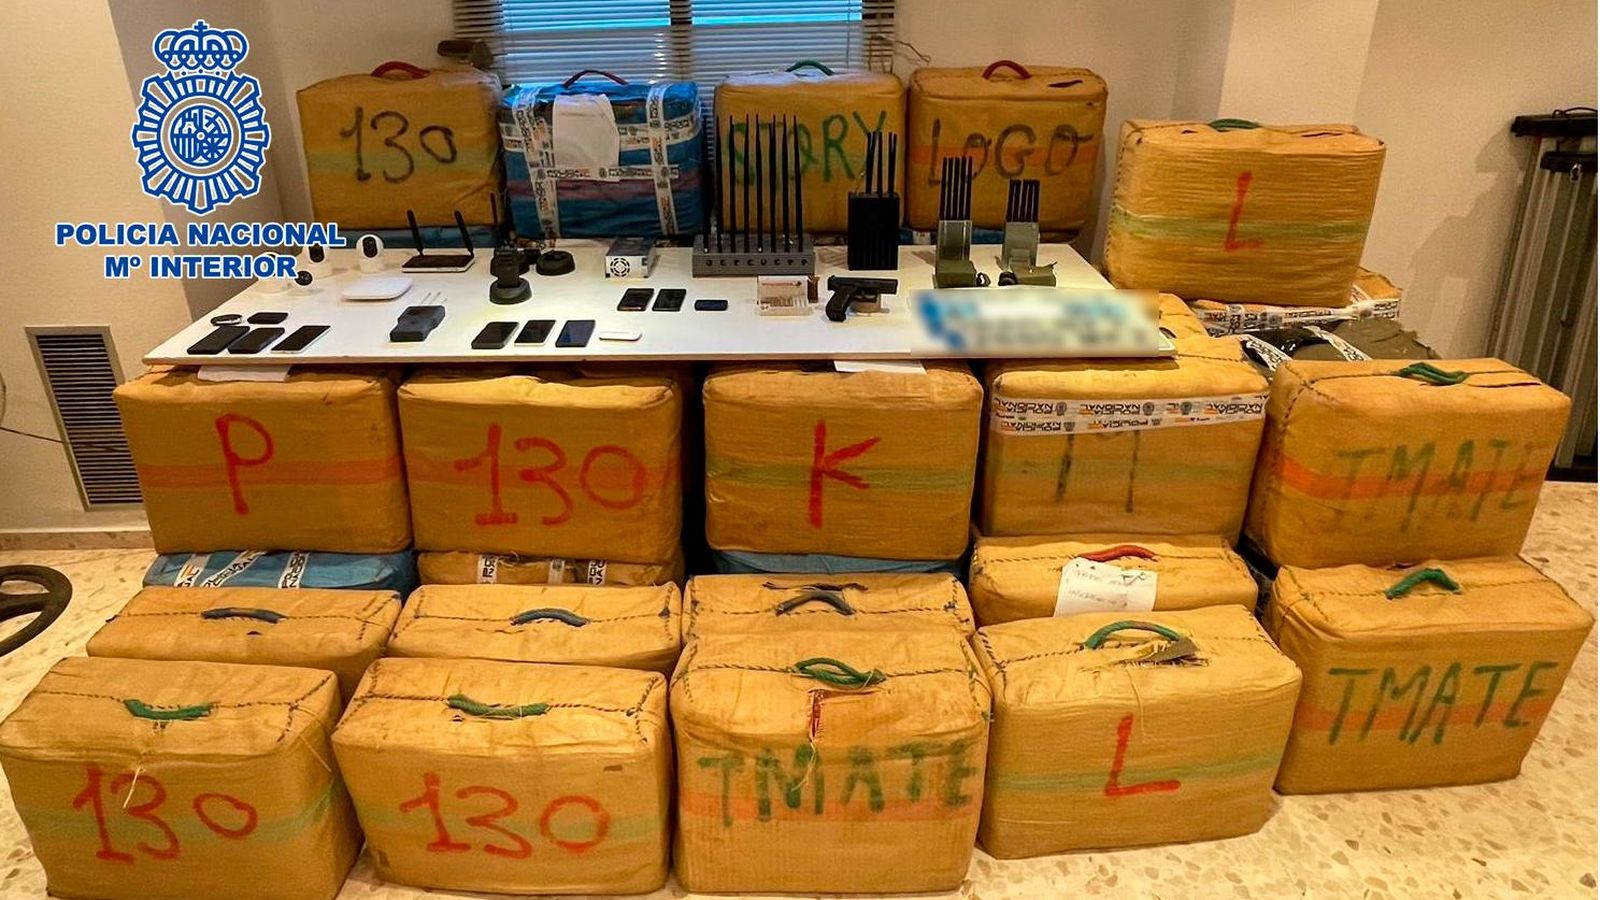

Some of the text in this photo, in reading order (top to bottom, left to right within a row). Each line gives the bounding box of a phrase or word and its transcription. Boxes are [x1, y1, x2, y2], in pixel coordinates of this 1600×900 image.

[339, 106, 457, 183] 130
[928, 118, 1094, 187] LOGO
[1225, 171, 1263, 252] L
[216, 413, 274, 515] P
[455, 424, 646, 525] 130
[809, 421, 881, 528] K
[1327, 662, 1559, 745] TMATE
[697, 741, 978, 827] TMATE
[1105, 713, 1182, 797] L
[74, 764, 258, 862] 130
[400, 771, 611, 859] 130
